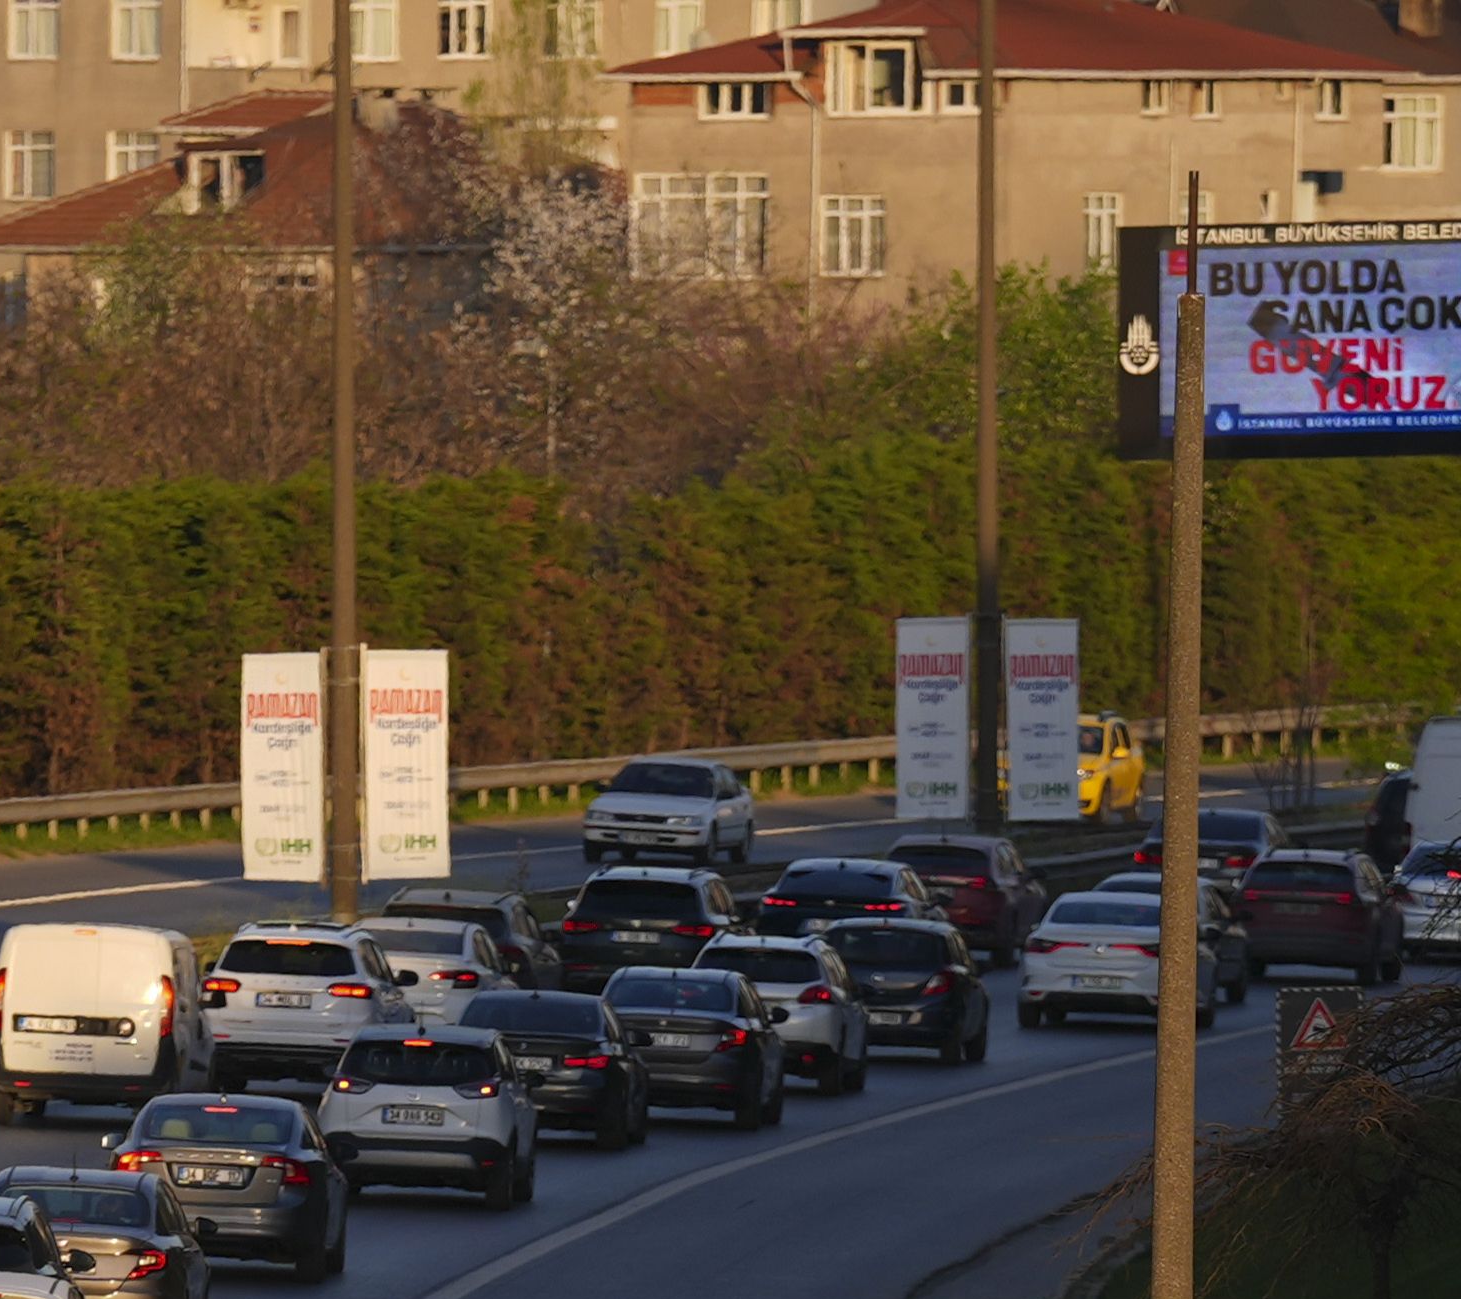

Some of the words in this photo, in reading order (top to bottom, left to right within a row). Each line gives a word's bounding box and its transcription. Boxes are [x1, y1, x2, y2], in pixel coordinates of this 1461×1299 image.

[1209, 261, 1264, 297] BU
[1273, 258, 1405, 295] YOLDA
[1311, 375, 1447, 412] YORUZ
[247, 692, 318, 728] RAMAZAN
[370, 688, 442, 724] RAMAZAN
